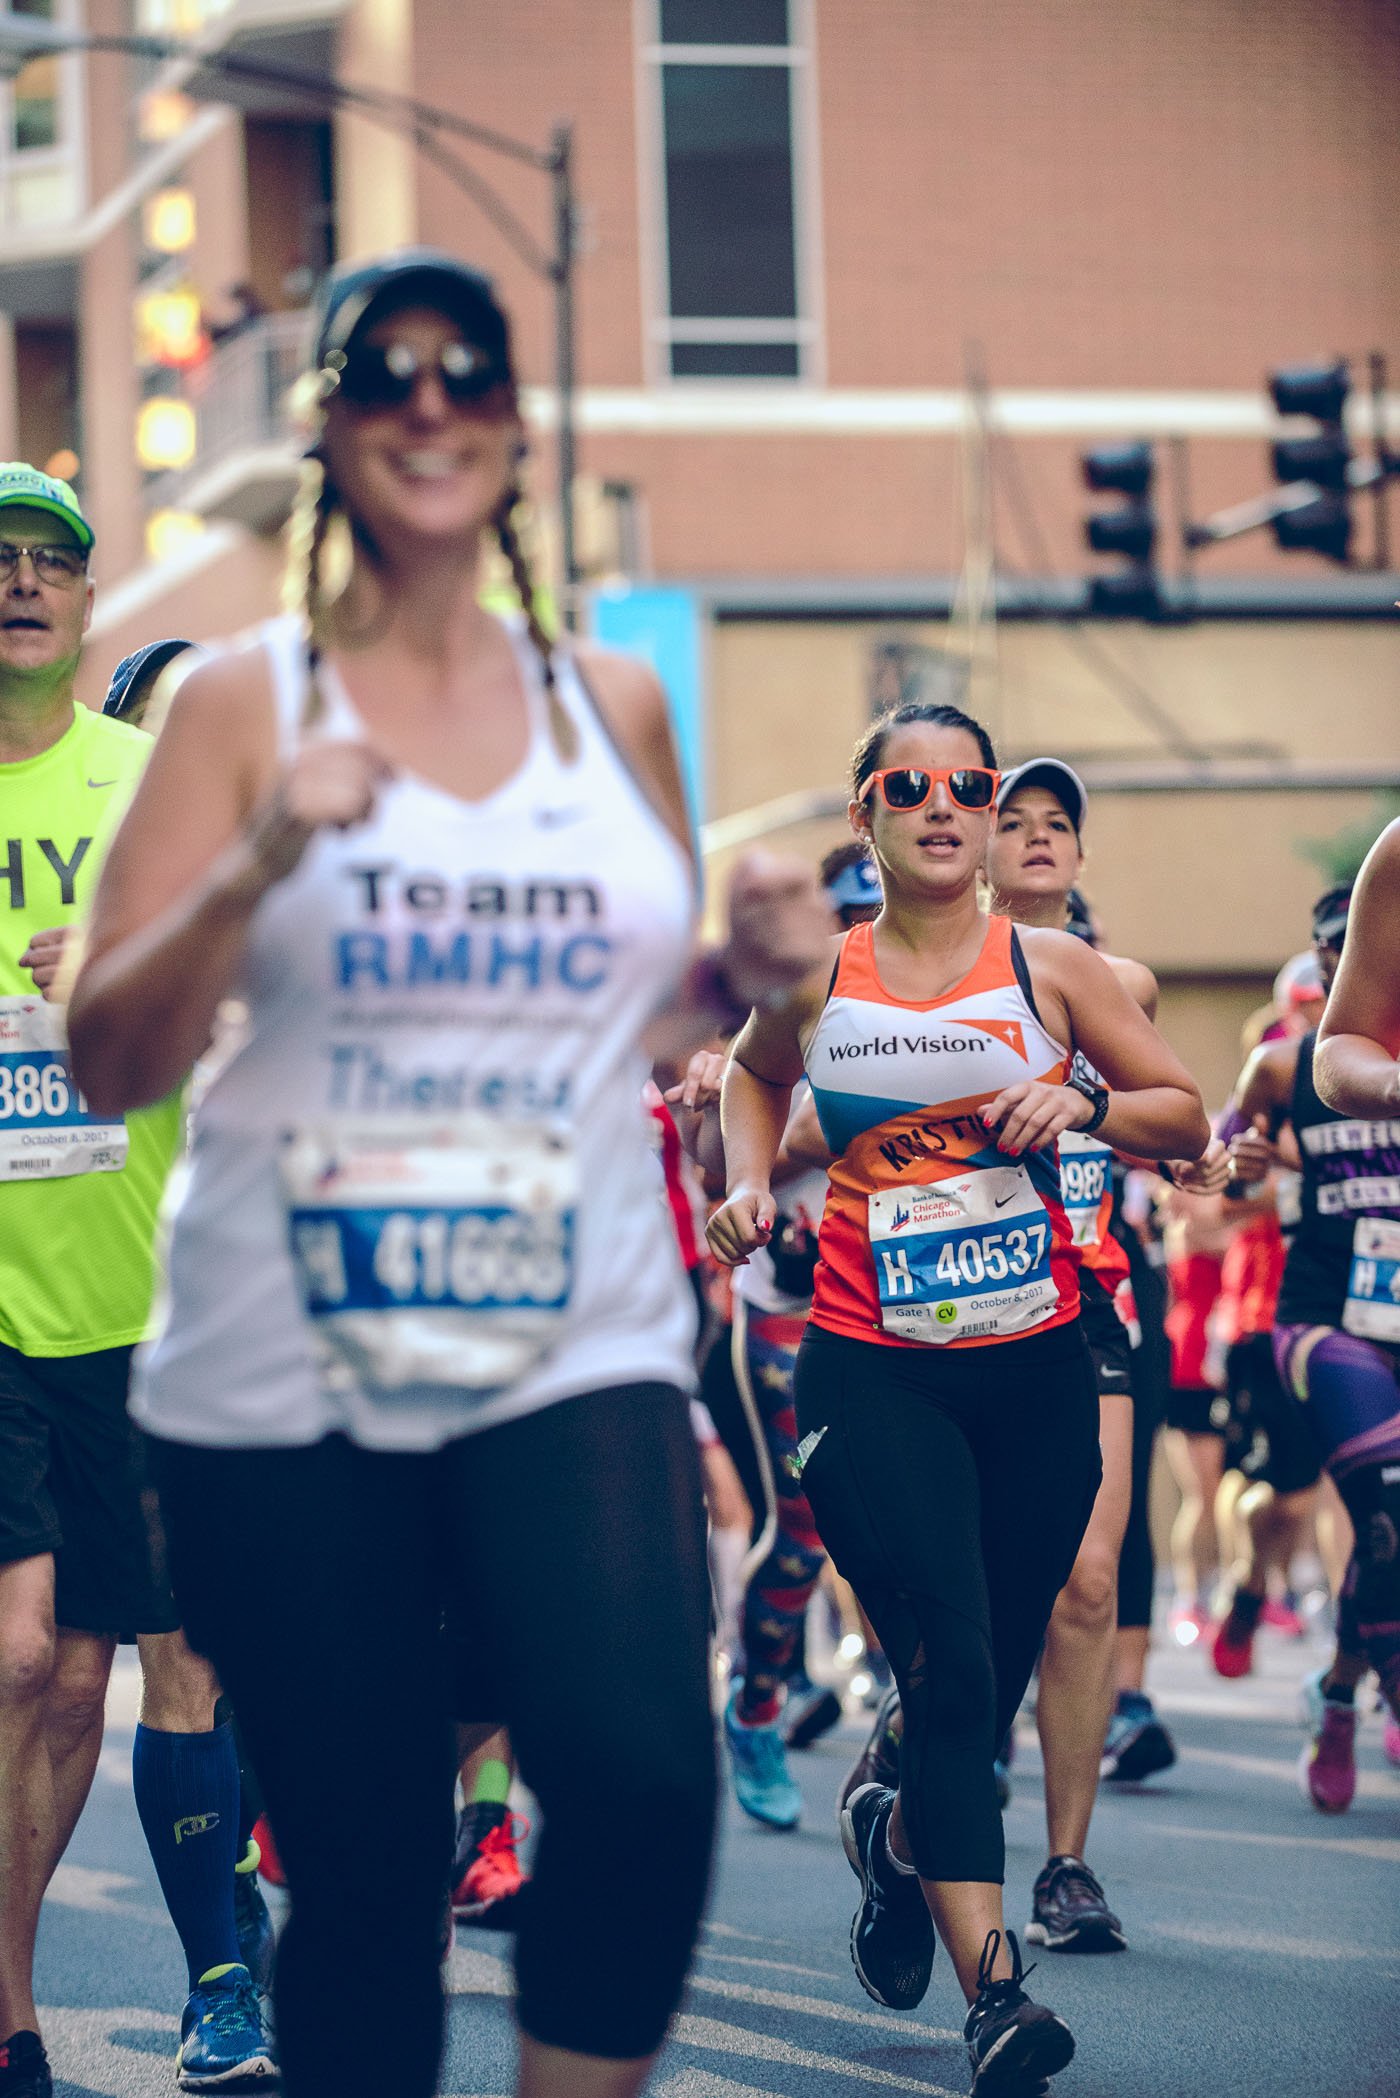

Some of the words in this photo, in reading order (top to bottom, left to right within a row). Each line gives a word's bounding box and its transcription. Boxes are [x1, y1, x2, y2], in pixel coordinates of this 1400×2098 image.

[345, 865, 606, 917] Team
[337, 932, 610, 990] RMHC
[829, 1036, 897, 1062] World
[22, 1134, 67, 1146] October
[913, 1200, 950, 1214] Chicago
[914, 1208, 961, 1223] Marathon
[881, 1248, 914, 1296] H
[936, 1223, 1047, 1287] 40537
[896, 1308, 923, 1317] Gate
[926, 1308, 931, 1317] 1
[938, 1307, 953, 1319] CV
[970, 1297, 1012, 1310] October
[1024, 1286, 1043, 1300] 2017
